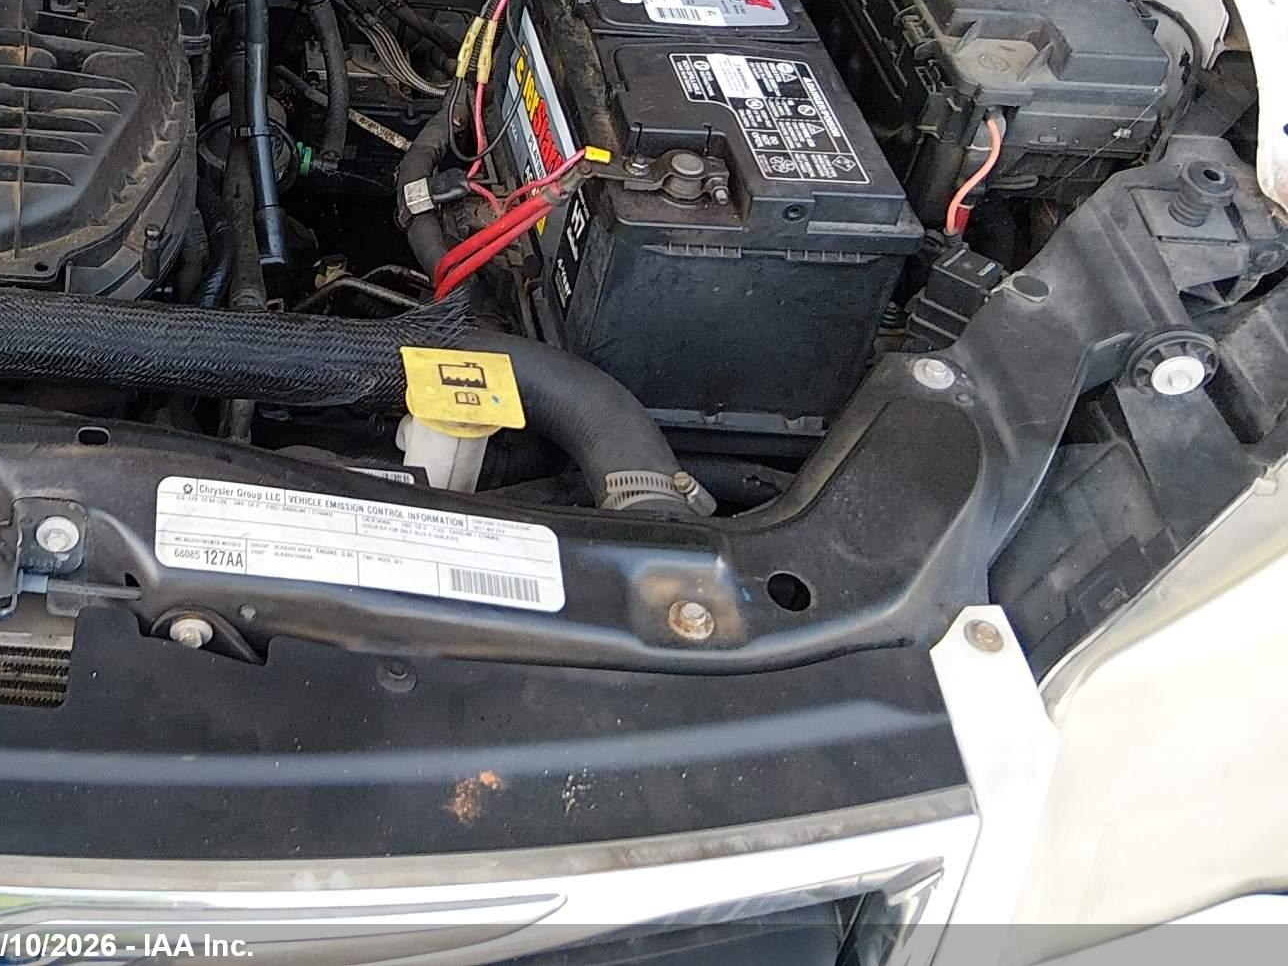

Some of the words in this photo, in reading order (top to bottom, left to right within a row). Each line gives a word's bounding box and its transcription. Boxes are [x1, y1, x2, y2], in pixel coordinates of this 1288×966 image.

[199, 484, 234, 497] Chrysler
[237, 489, 262, 500] Group
[265, 491, 281, 502] LLC
[289, 494, 322, 507] VEHICLE
[325, 499, 364, 513] EMISSION
[367, 505, 405, 519] CONTROL
[407, 512, 464, 527] INFORMATION
[174, 548, 200, 560] 68085
[203, 549, 243, 568] 127AA
